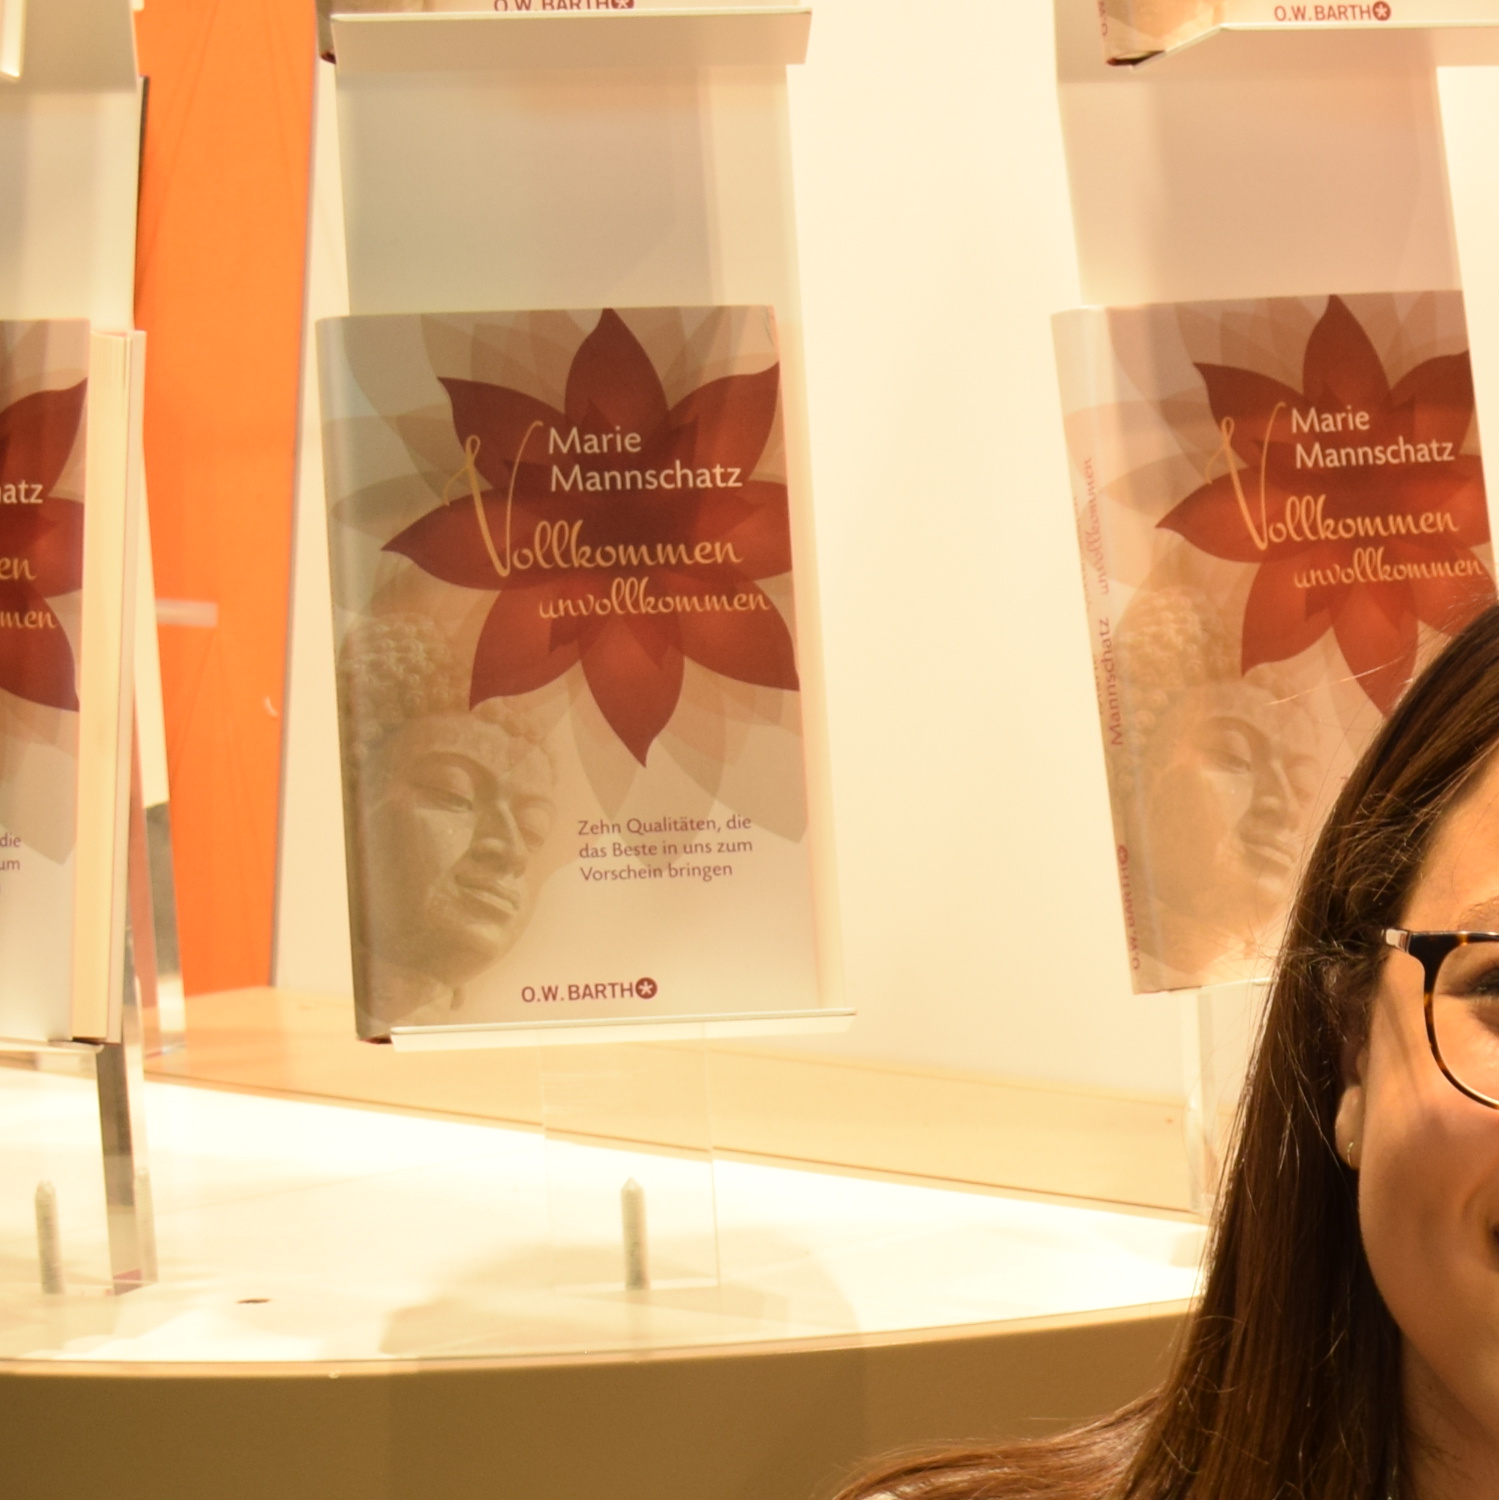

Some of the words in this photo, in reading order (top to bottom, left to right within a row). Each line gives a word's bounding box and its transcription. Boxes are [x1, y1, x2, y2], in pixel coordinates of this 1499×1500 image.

[1274, 5, 1312, 21] O.W.
[1315, 4, 1371, 21] BARTH
[1291, 405, 1370, 434] Marie
[548, 425, 642, 455] Marie
[1295, 438, 1455, 470] Mannschatz
[550, 460, 743, 492] Mannschatz
[1207, 402, 1459, 552] Vollkommen
[443, 419, 744, 577] Vollkommen
[1293, 547, 1484, 590] unvollkommen
[538, 576, 774, 619] unvollkommen
[577, 817, 622, 836] Zehn
[626, 814, 721, 837] Qualitäten,
[726, 813, 752, 831] die
[578, 841, 607, 860] das
[611, 840, 657, 859] Beste
[662, 839, 677, 856] in
[682, 841, 712, 856] uns
[717, 839, 754, 854] zum
[0, 861, 21, 871] um
[580, 862, 662, 881] Vorschein
[667, 860, 733, 882] bringen
[521, 985, 564, 1003] O.W.
[568, 981, 635, 1002] BARTH
